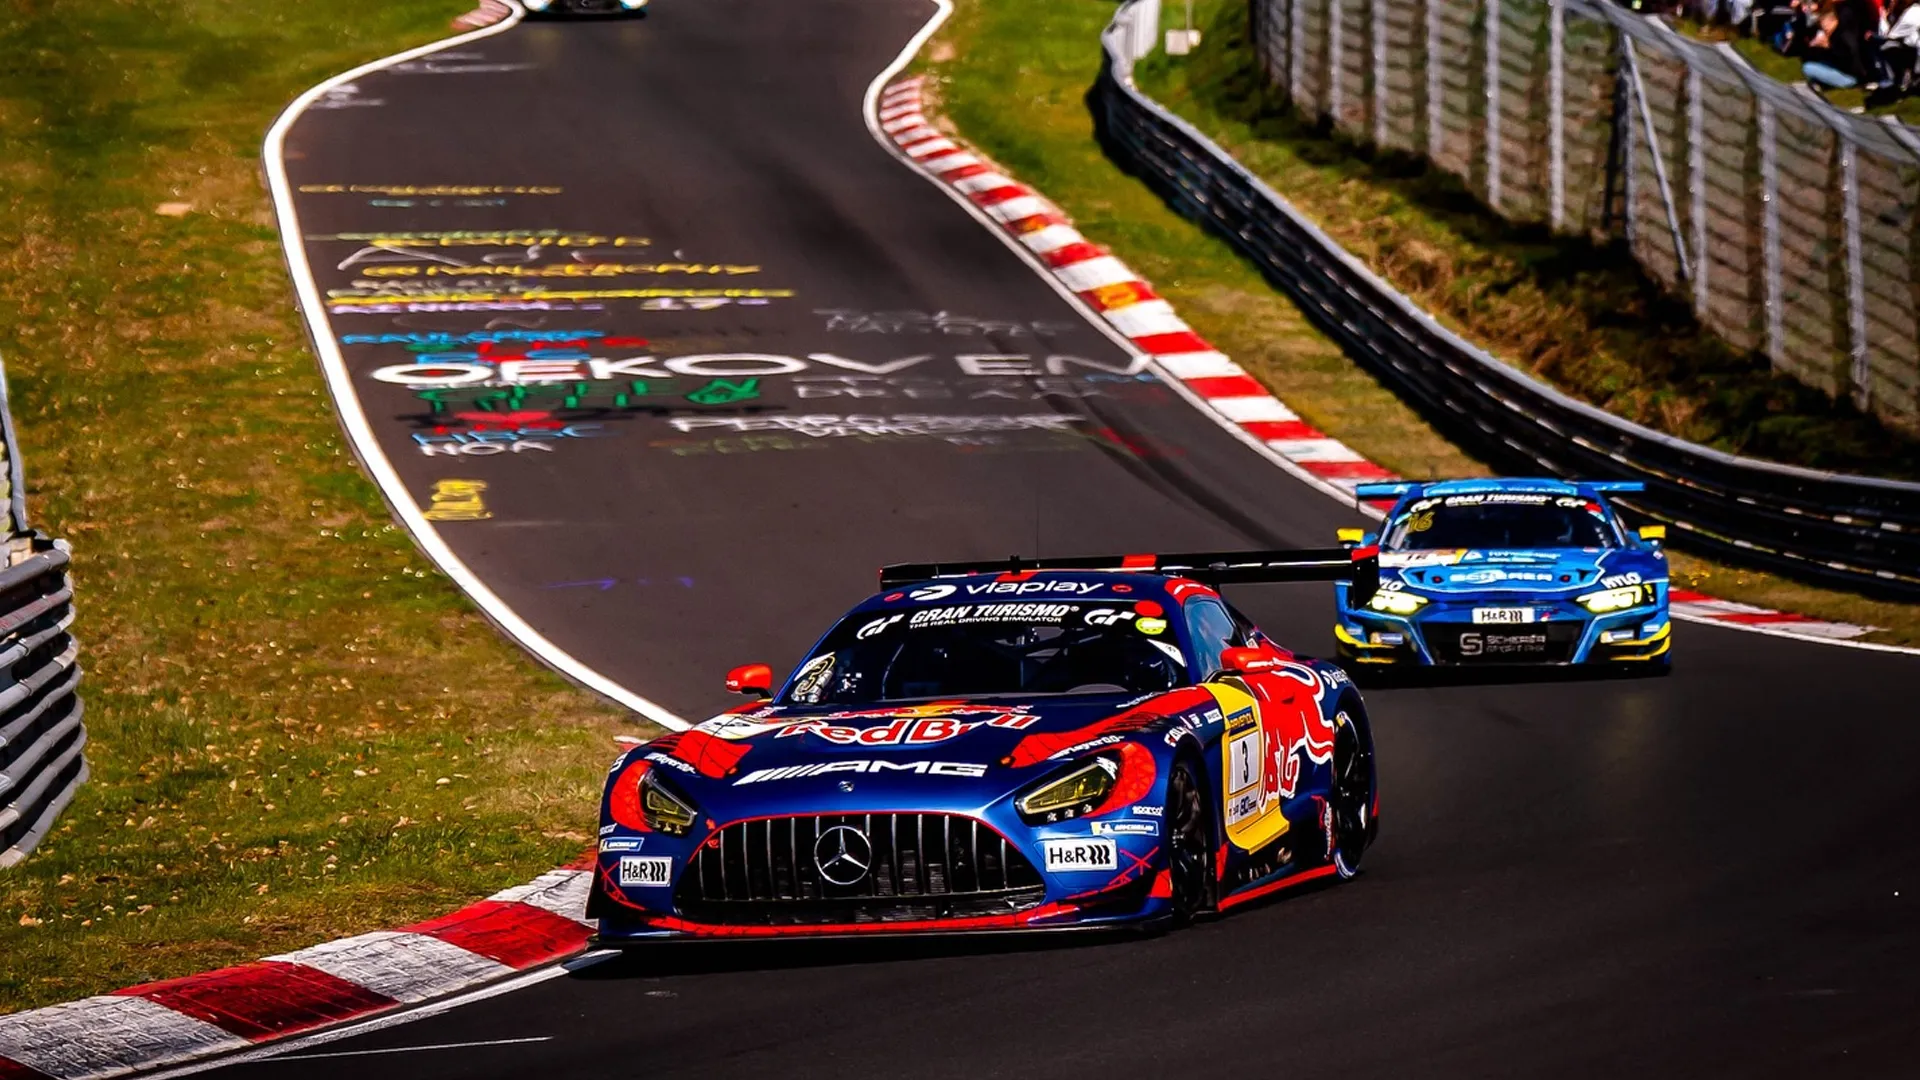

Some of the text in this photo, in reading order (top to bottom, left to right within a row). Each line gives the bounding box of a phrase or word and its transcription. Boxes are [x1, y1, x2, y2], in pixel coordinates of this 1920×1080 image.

[371, 352, 1153, 387] OEKOVEN
[966, 580, 1105, 596] viaplay
[909, 605, 973, 624] GRAN
[929, 619, 956, 627] REAL
[958, 616, 1000, 624] DRIVING
[774, 713, 1042, 746] Red Bull
[813, 760, 988, 778] AMG
[1241, 740, 1250, 784] 3
